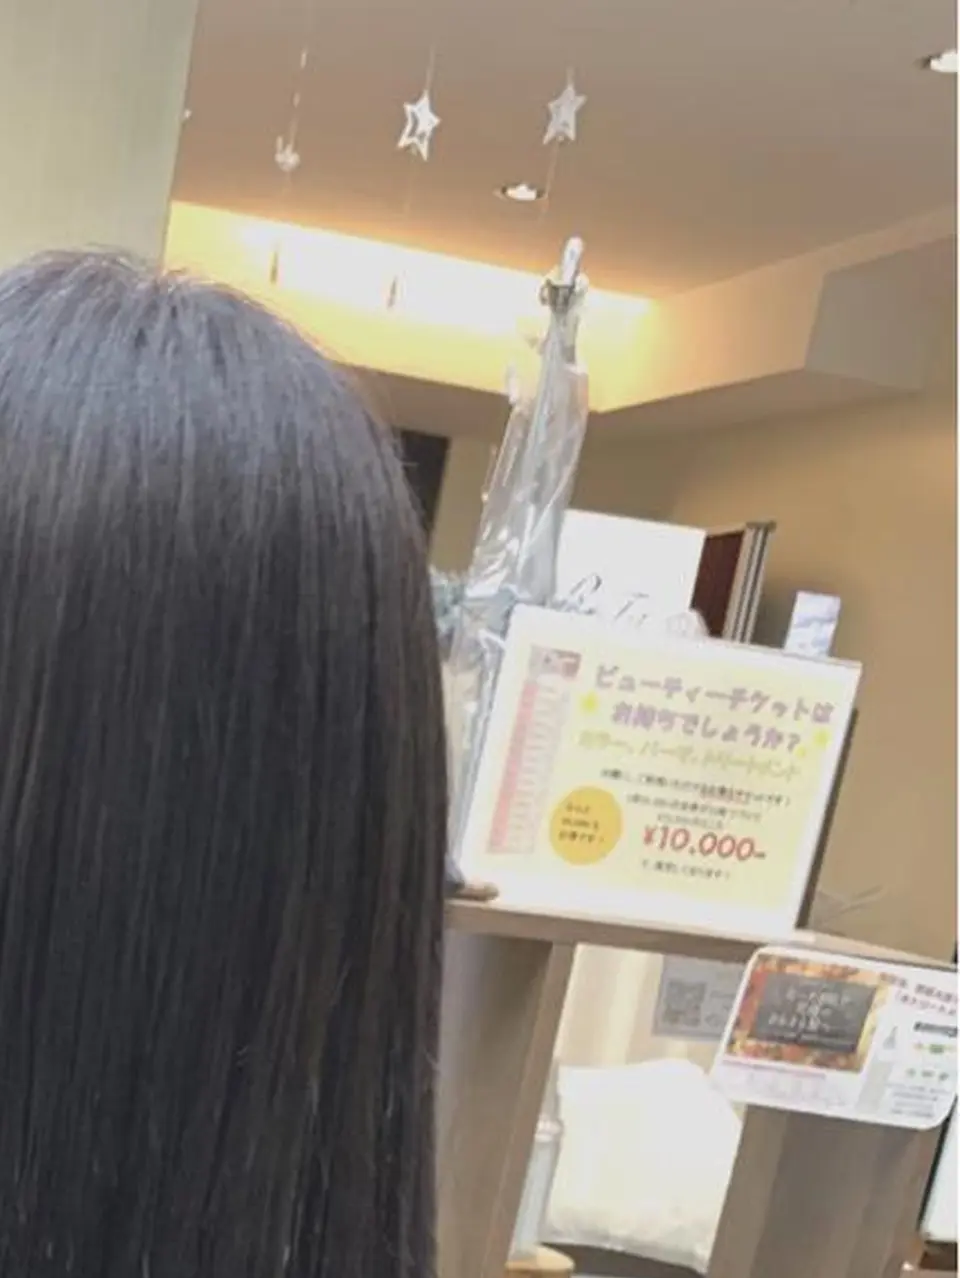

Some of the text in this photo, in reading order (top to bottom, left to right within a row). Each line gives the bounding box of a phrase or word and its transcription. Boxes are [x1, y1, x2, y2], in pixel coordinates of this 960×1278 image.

[596, 664, 836, 724] ビューティーチケットは
